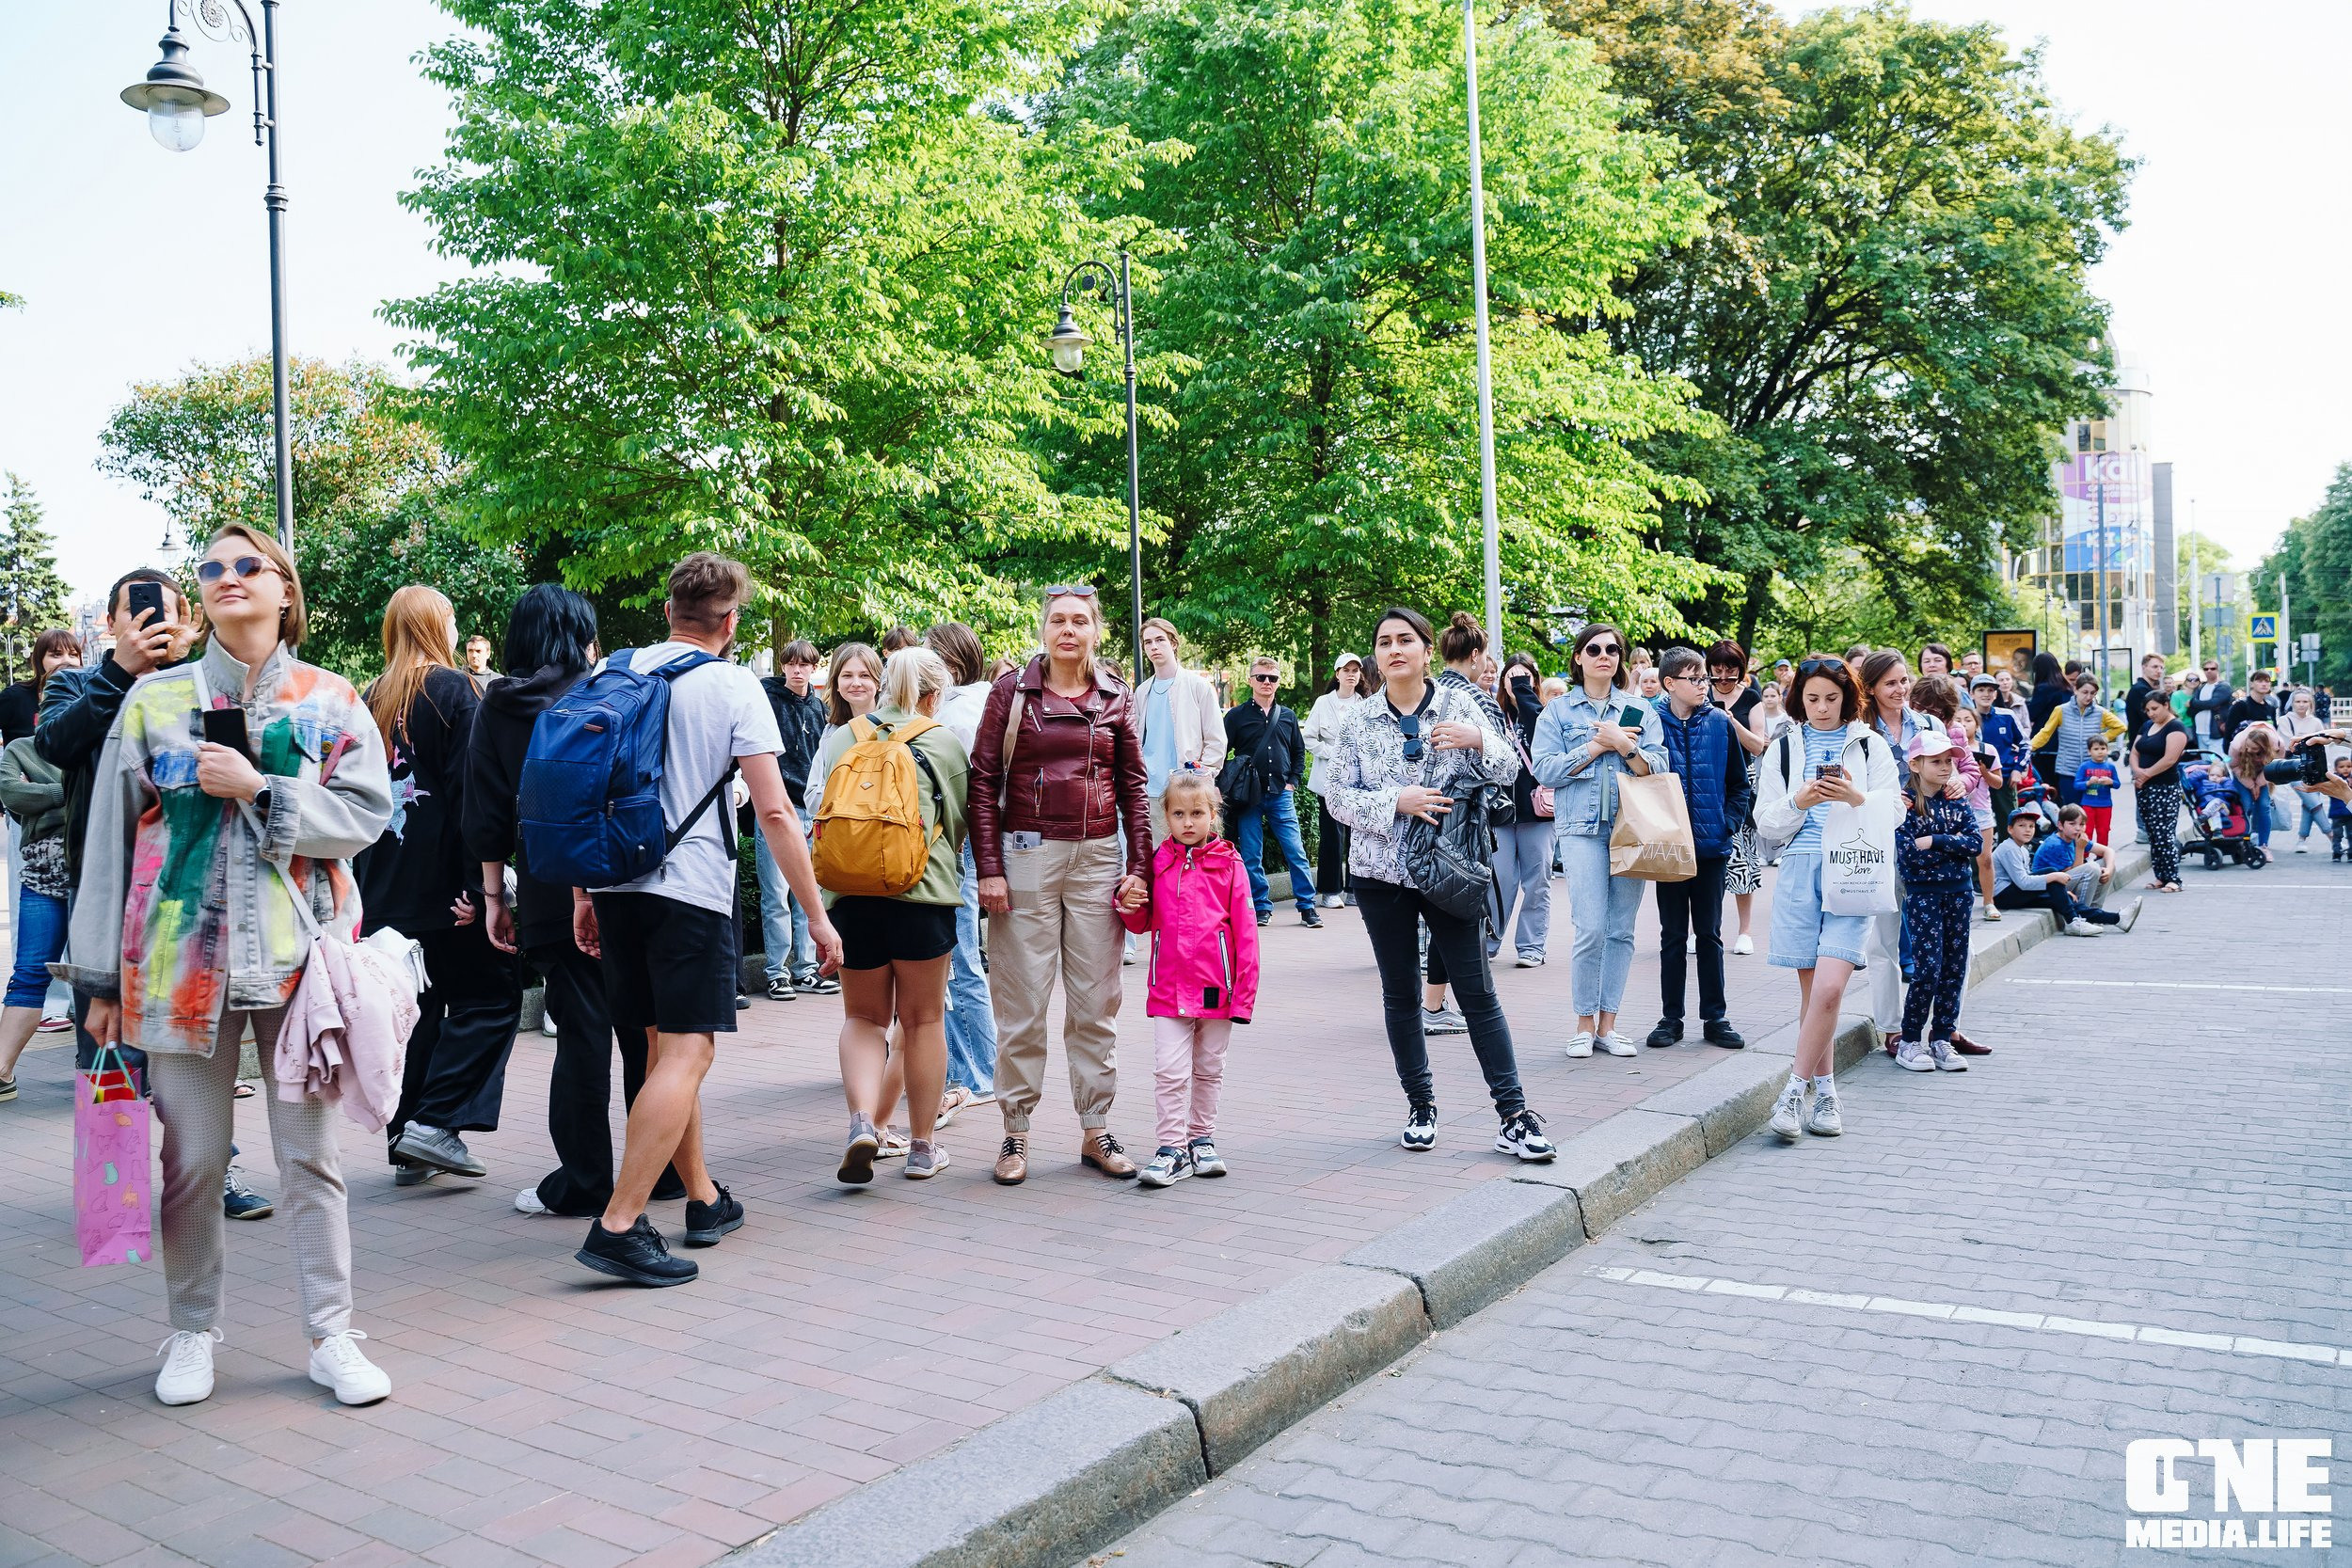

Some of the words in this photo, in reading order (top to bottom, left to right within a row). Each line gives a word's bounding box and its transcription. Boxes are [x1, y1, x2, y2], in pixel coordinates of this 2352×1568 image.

[1638, 840, 1693, 863] MAAG
[1830, 850, 1858, 863] MUST
[1860, 850, 1884, 863] HAVE
[1843, 860, 1873, 878] Store
